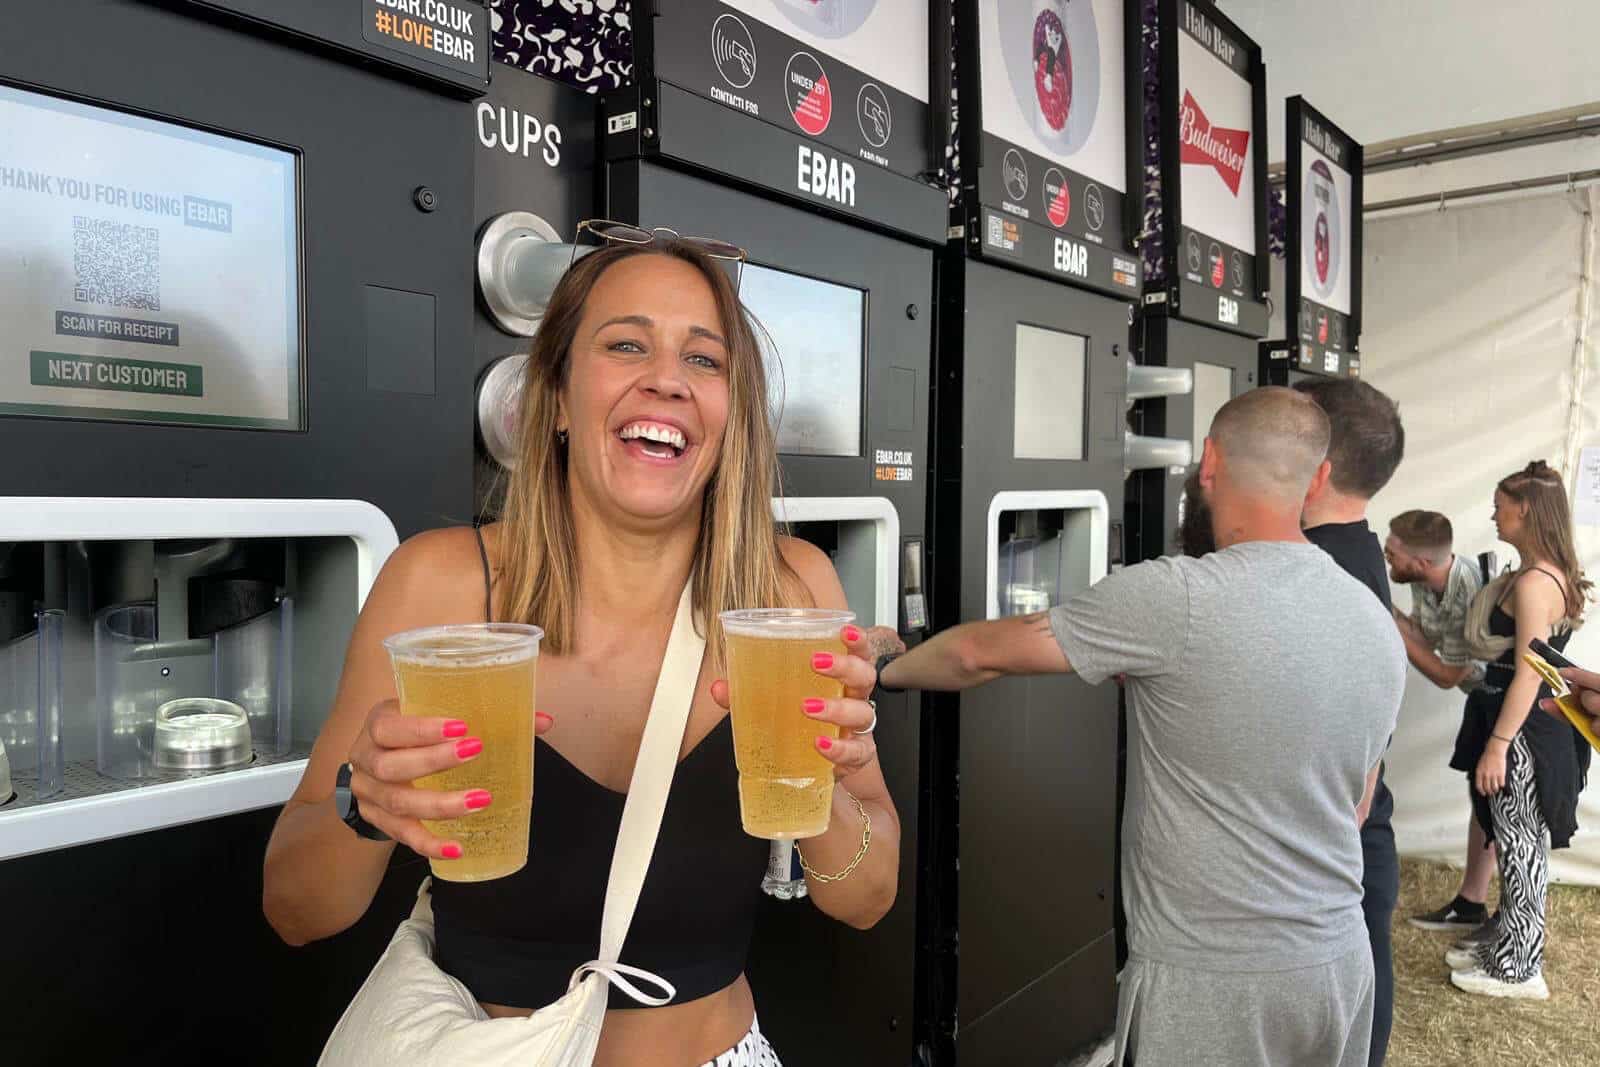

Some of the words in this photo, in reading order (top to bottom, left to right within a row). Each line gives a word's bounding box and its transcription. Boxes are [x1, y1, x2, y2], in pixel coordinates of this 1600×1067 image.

[375, 10, 475, 63] #LOVEEBAR
[376, 0, 473, 36] AR.CO.UK
[1185, 2, 1211, 48] Halo
[1213, 24, 1235, 65] Bar
[791, 71, 814, 90] UNDER
[476, 102, 562, 167] CUPS
[1180, 105, 1244, 173] Budweiser
[797, 144, 856, 208] EBAR
[56, 177, 91, 201] YOU
[94, 183, 128, 207] FOR
[131, 191, 181, 217] USING
[189, 202, 229, 226] EBAR
[1053, 236, 1088, 277] EBAR
[62, 315, 95, 332] SCAN
[98, 319, 122, 334] FOR
[124, 322, 174, 341] RECEIPT
[1218, 296, 1238, 325] EBAR
[48, 359, 93, 382] NEXT
[96, 363, 187, 389] CUSTOMER
